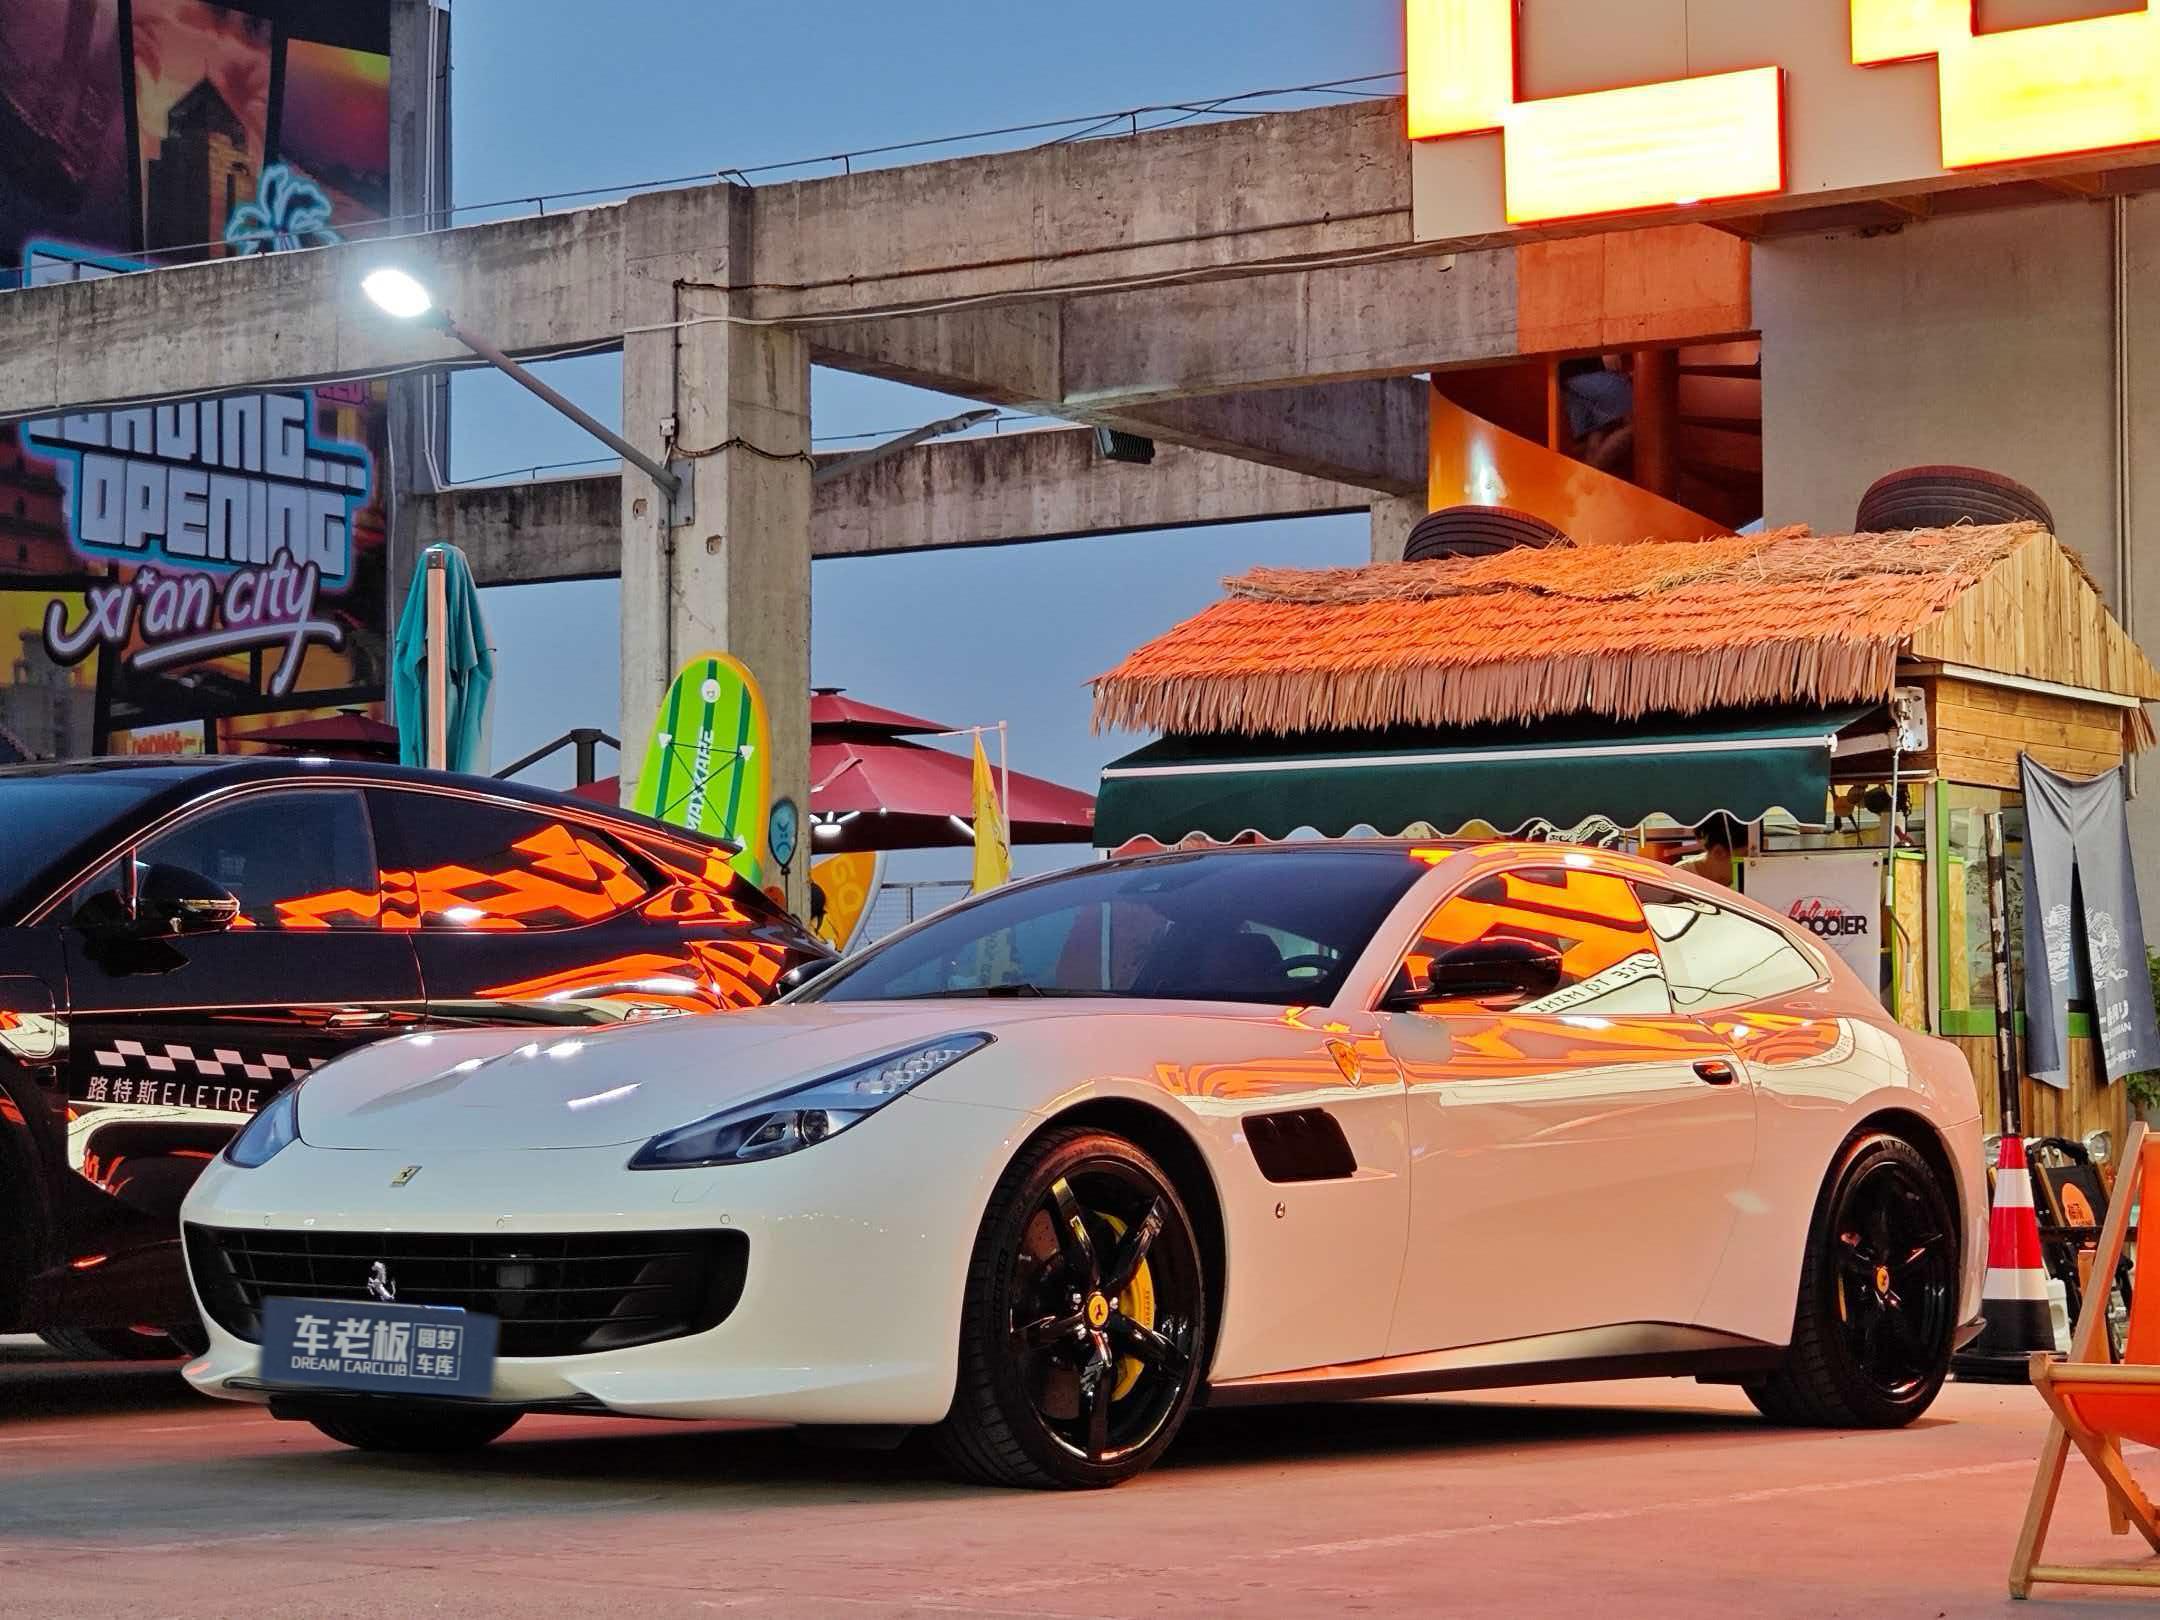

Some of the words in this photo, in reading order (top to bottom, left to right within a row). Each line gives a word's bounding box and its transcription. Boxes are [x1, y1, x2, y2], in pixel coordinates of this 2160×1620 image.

[81, 452, 347, 575] OPENING
[224, 551, 319, 696] city
[86, 1076, 158, 1105] 路特斯
[161, 1084, 259, 1112] ELETRE
